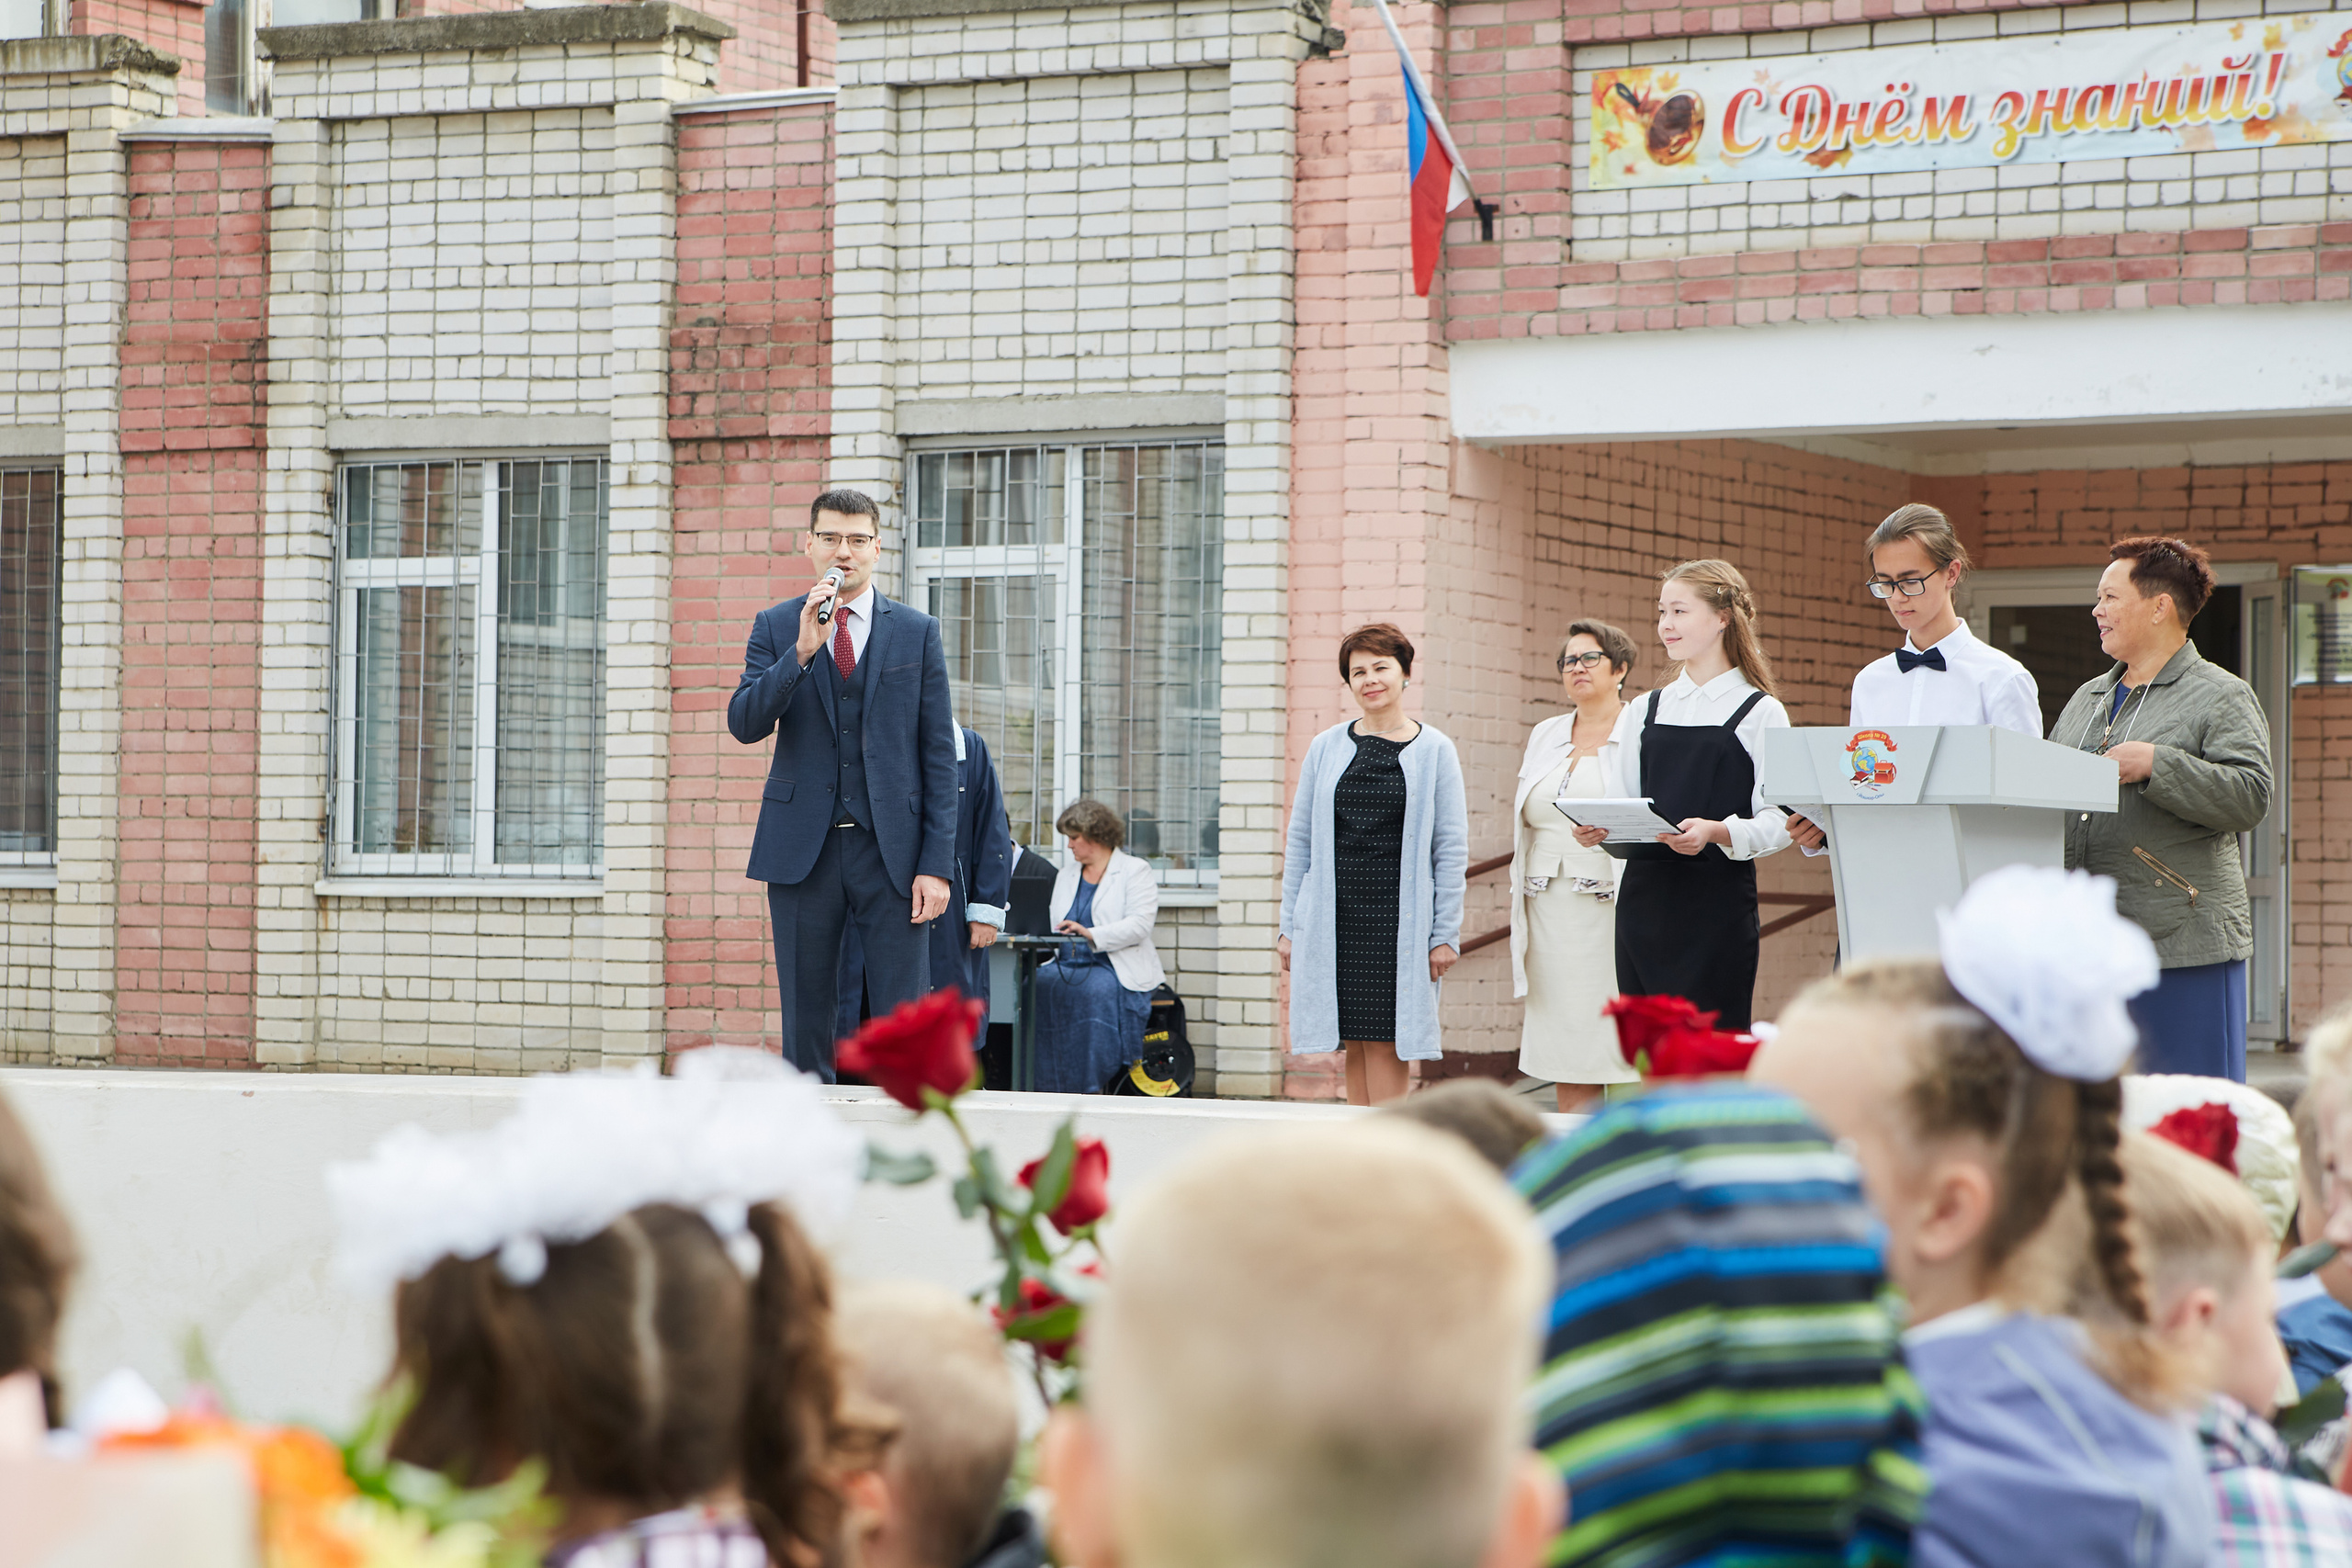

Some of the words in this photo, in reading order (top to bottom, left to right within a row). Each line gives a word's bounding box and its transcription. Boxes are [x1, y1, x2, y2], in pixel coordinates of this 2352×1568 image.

[1721, 87, 1765, 155] С
[1777, 82, 1973, 153] Днём
[1989, 52, 2285, 159] знаний!
[1143, 1031, 1169, 1041] TAYER
